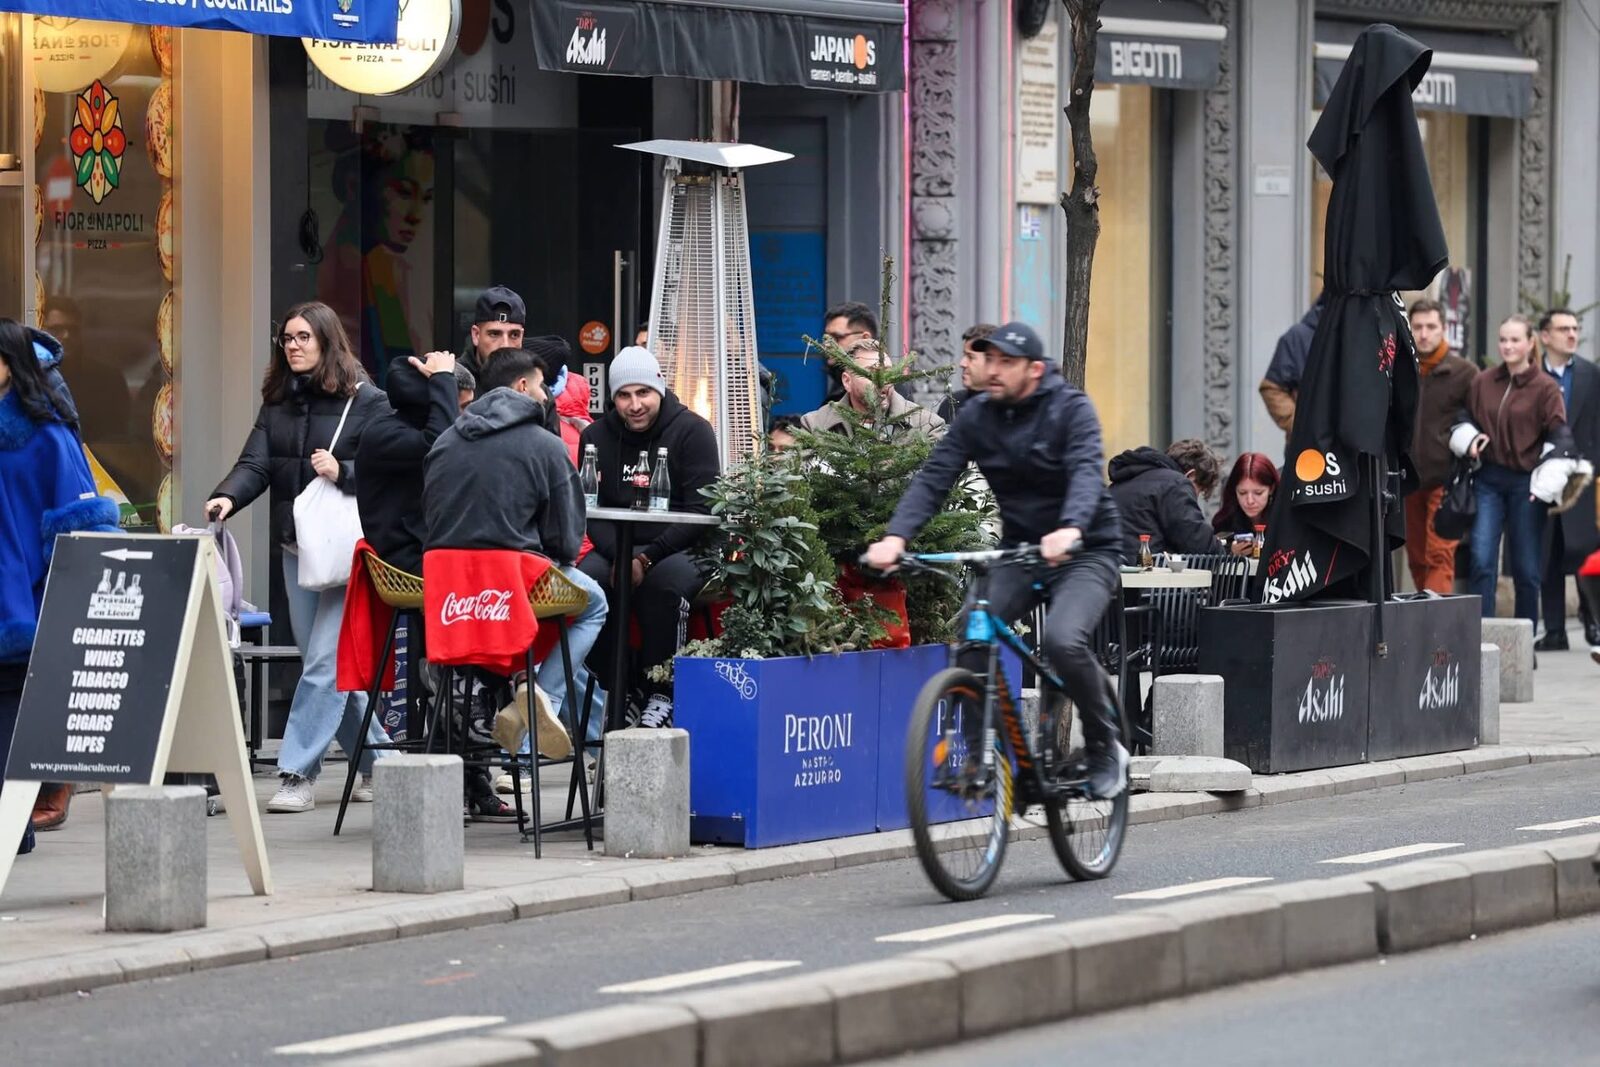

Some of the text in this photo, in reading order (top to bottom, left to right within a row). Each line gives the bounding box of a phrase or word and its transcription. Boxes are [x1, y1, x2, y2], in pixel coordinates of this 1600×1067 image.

[566, 25, 606, 65] Asahi
[356, 54, 384, 63] PIZZA
[1110, 41, 1182, 79] BIGOTTI
[464, 65, 515, 104] sushi
[55, 211, 84, 230] FIOR
[97, 213, 143, 231] NAPOLI
[87, 239, 107, 249] PIZZA
[589, 366, 599, 409] PUSH
[1305, 479, 1346, 496] sushi
[440, 589, 513, 626] Coca-Cola
[72, 627, 146, 647] CIGARETTES
[84, 649, 125, 667] WINES
[72, 670, 129, 689] TABACCO
[1419, 661, 1459, 710] Asahi
[68, 692, 122, 711] LIQUORS
[1298, 673, 1345, 724] Asahi
[66, 713, 114, 732] CIGARS
[784, 712, 852, 754] PERONI
[66, 735, 106, 753] VAPES
[794, 768, 842, 787] AZZURRO
